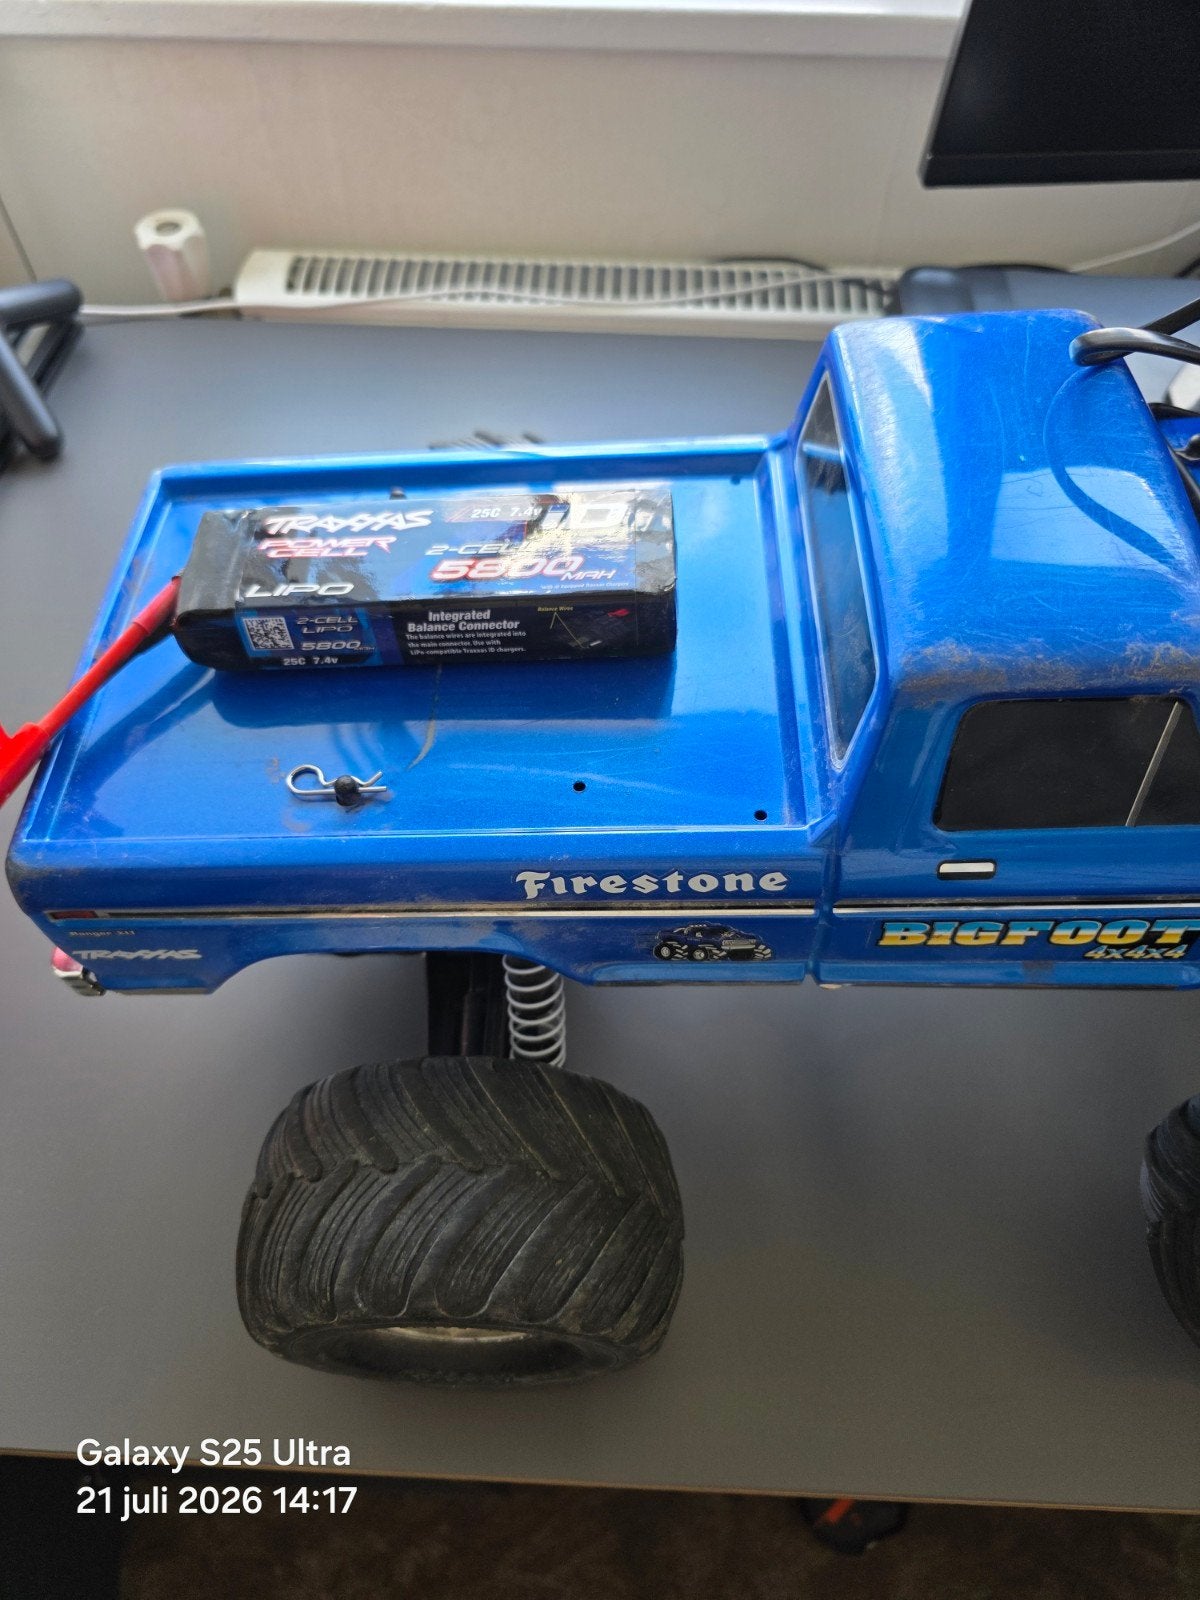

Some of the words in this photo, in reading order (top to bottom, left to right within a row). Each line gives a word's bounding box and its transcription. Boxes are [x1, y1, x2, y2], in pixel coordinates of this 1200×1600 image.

[471, 507, 501, 519] 25C
[264, 510, 434, 535] TRAXXAS
[258, 536, 398, 554] POWER
[266, 548, 369, 558] CELL
[429, 555, 585, 582] 5800
[244, 583, 355, 598] LIPO
[297, 616, 358, 625] 2-CELL
[428, 609, 492, 623] Integrated
[302, 625, 354, 634] LIPO
[407, 622, 456, 633] Balance
[458, 620, 520, 631] Connector
[476, 631, 511, 639] integrated
[301, 640, 361, 651] 5800
[283, 657, 306, 666] 25C
[312, 656, 339, 665] 7.4v
[515, 869, 788, 900] Firestone
[877, 919, 1200, 946] BIGFOOT
[72, 949, 203, 960] TRAXXAS
[1084, 944, 1188, 960] 4x4x4
